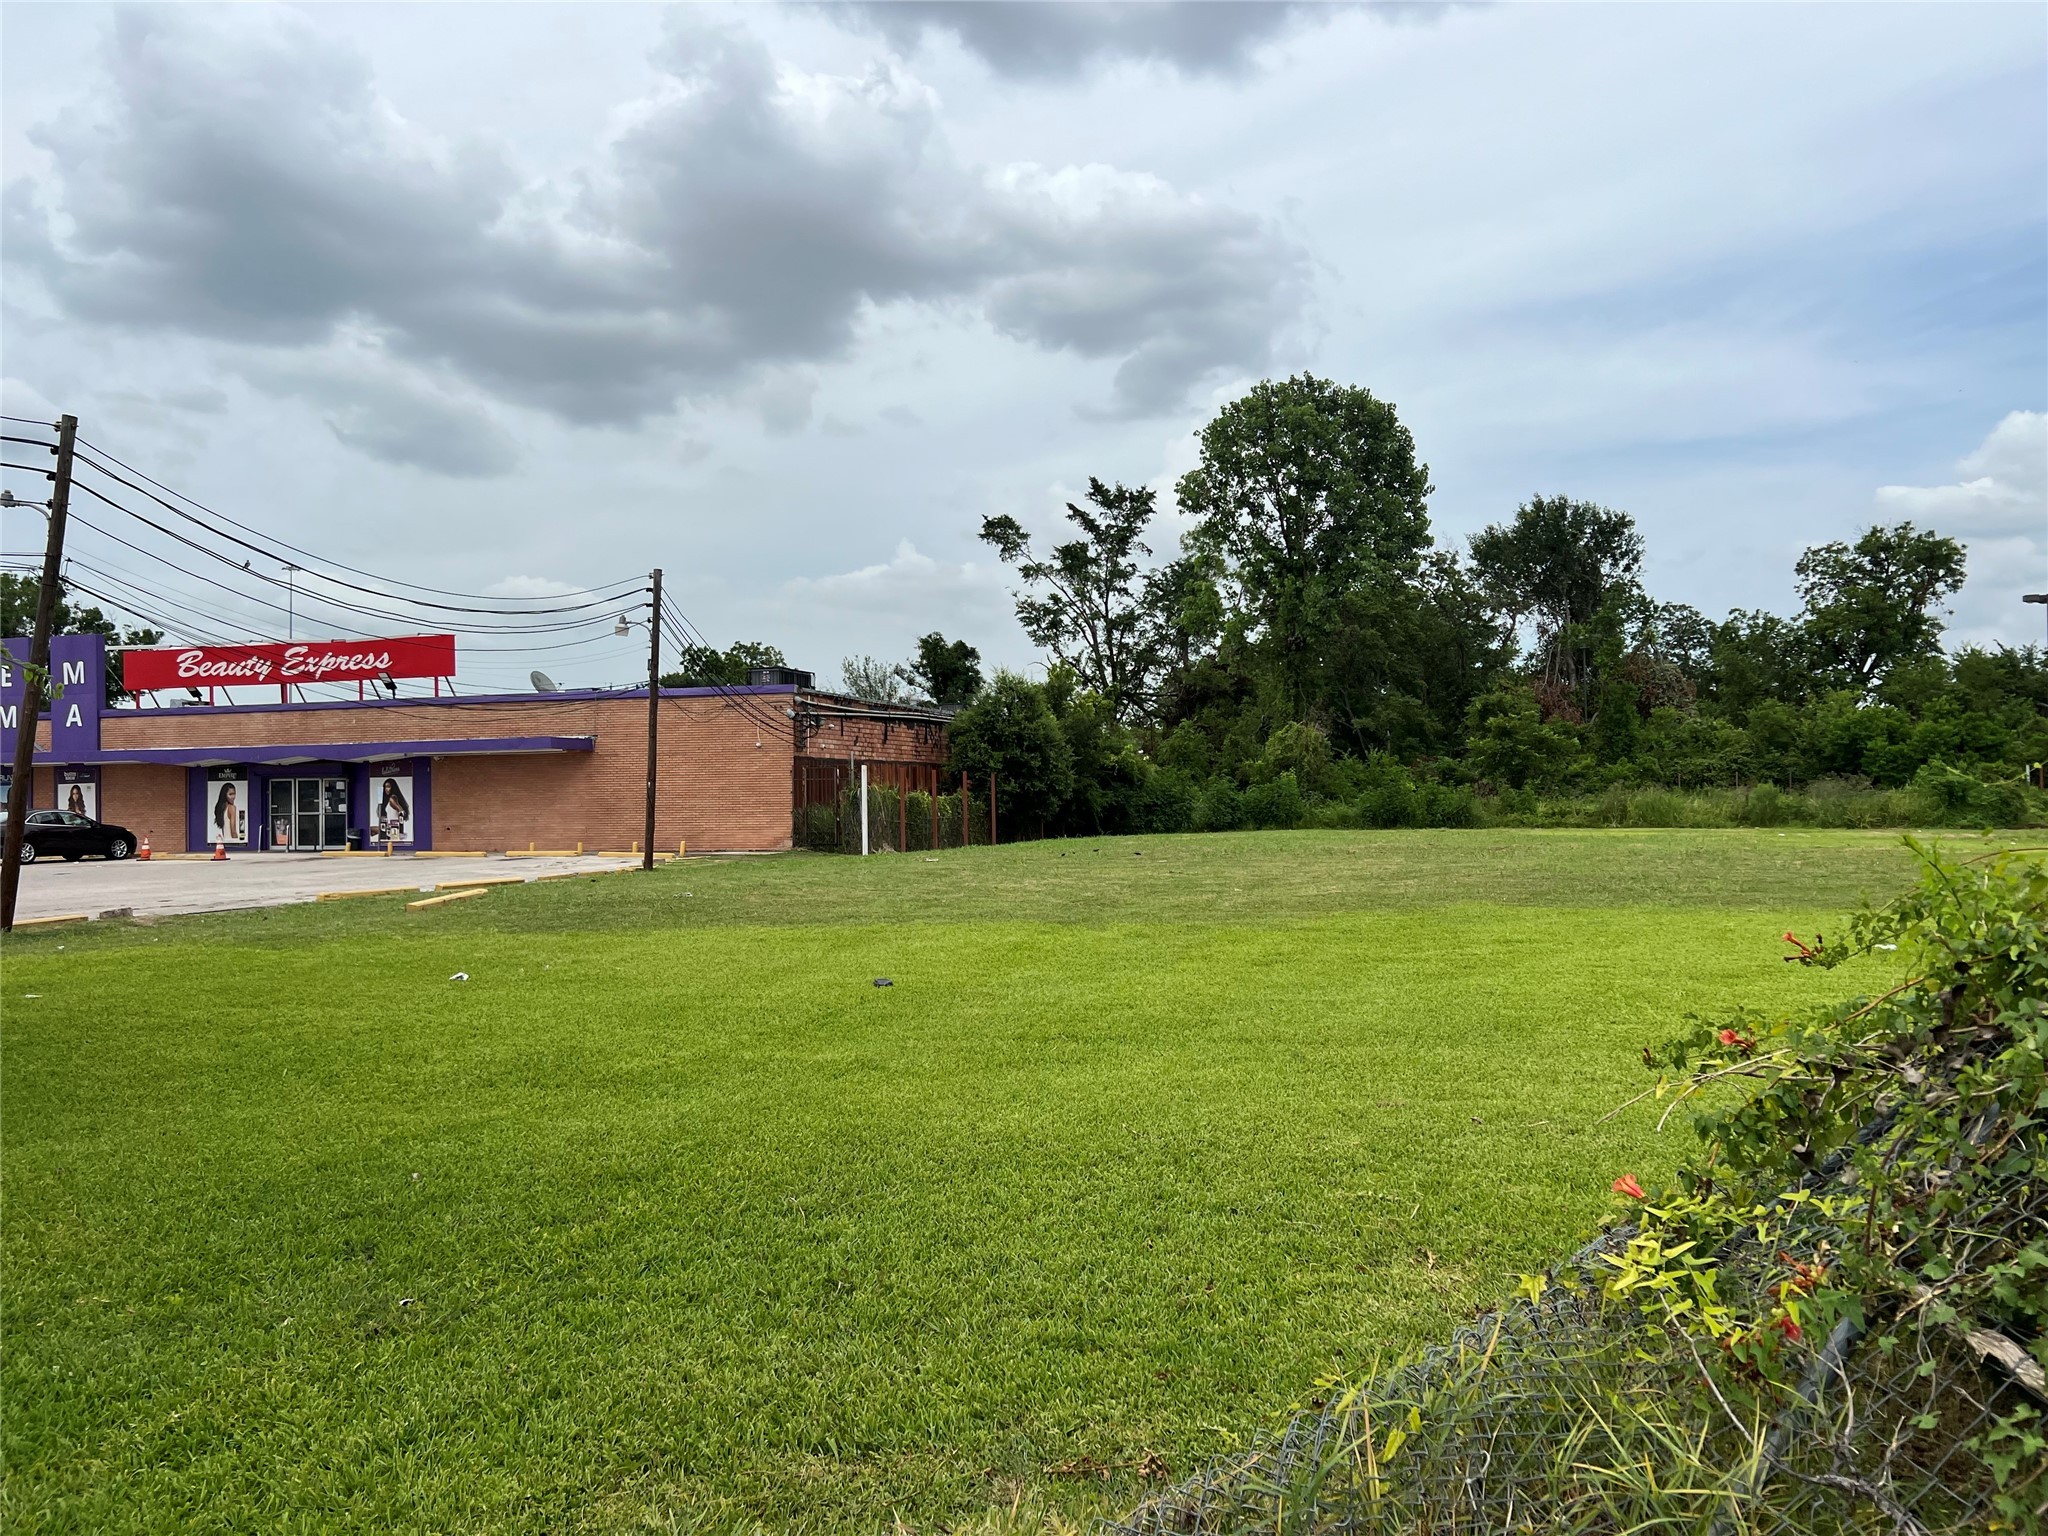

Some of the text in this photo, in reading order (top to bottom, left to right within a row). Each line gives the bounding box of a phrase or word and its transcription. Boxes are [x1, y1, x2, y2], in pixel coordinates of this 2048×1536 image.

[62, 660, 85, 686] M
[176, 645, 393, 682] Beauty Express
[65, 703, 83, 728] A
